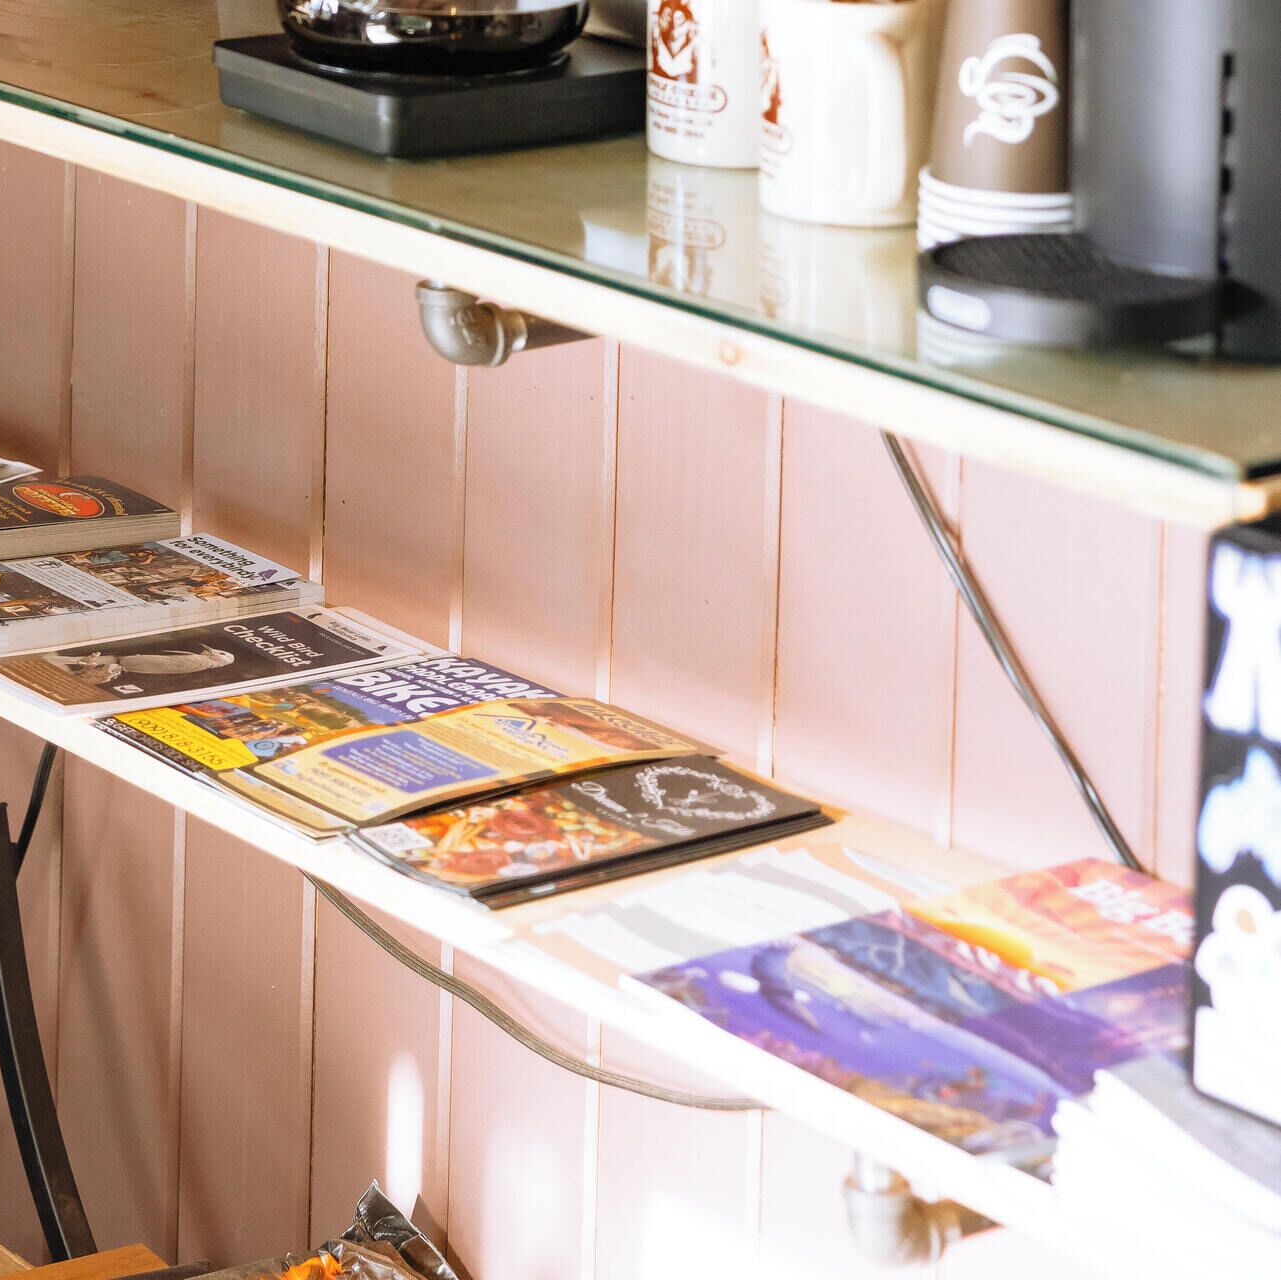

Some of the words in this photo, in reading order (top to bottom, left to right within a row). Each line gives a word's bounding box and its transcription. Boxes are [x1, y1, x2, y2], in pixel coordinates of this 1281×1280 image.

[170, 540, 193, 552] for
[187, 536, 256, 566] Something
[223, 624, 312, 667] Checklist
[257, 625, 294, 642] Wild
[288, 641, 324, 657] Bird
[335, 671, 462, 717] BIKE
